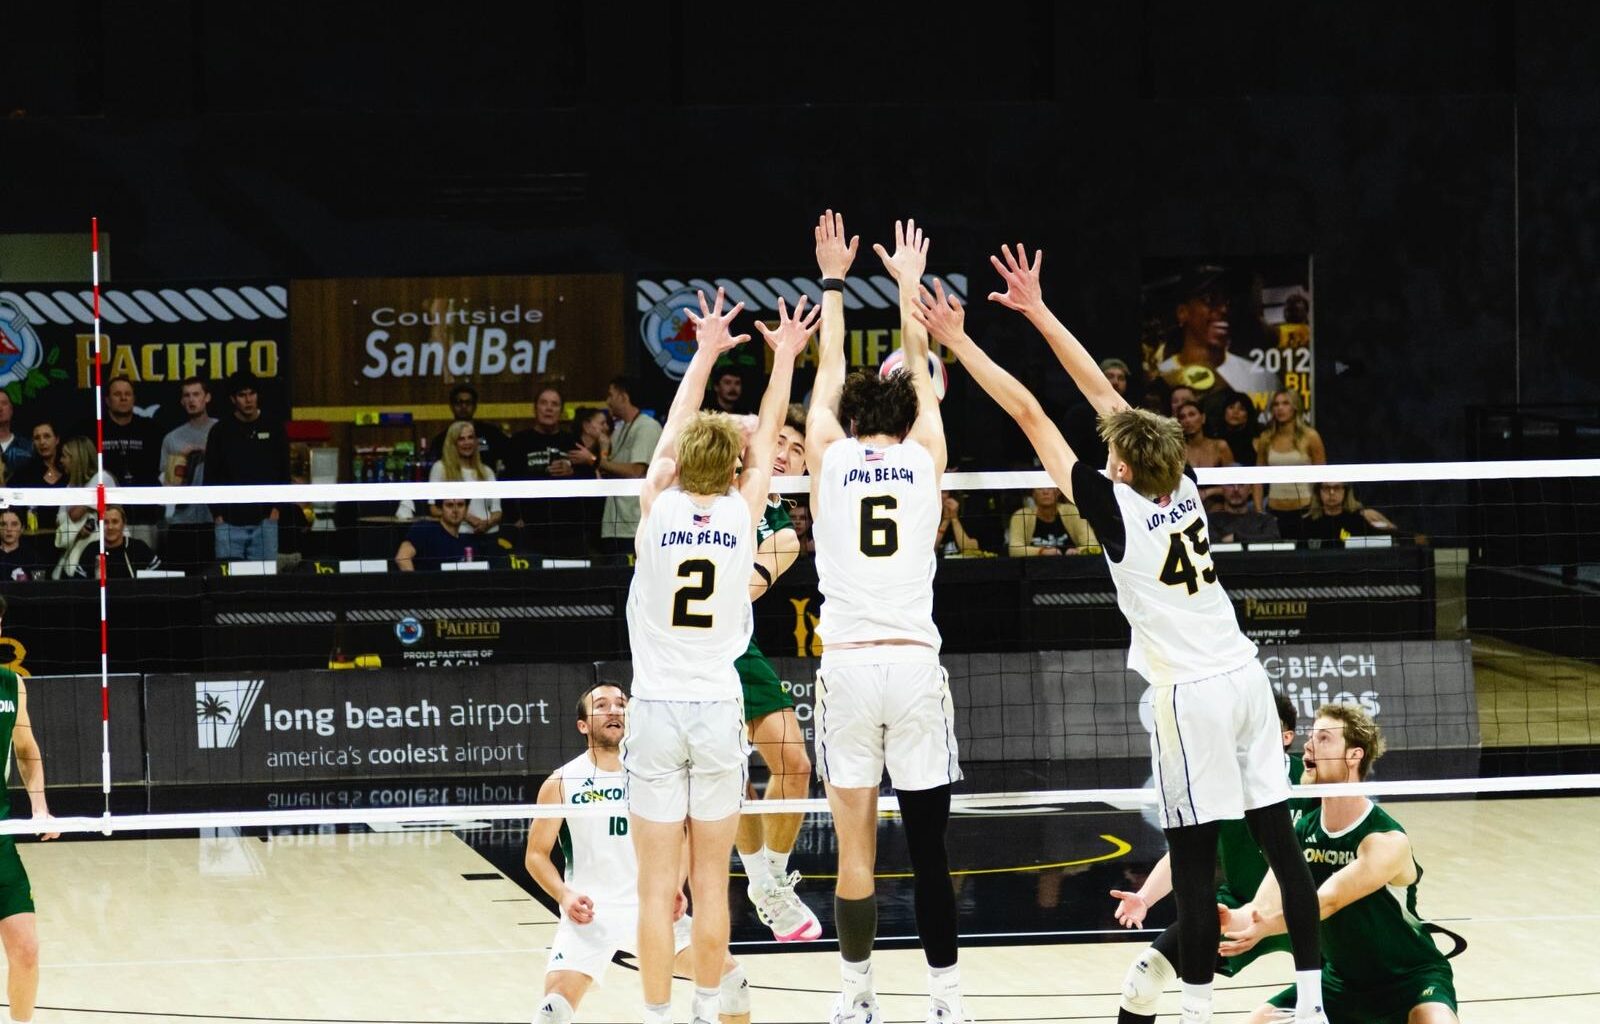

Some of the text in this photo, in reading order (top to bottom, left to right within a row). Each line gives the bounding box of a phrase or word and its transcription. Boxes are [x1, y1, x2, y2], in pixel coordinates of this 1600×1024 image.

[371, 304, 543, 327] Courtside
[362, 325, 556, 378] SandBar
[1249, 347, 1311, 373] 2012
[875, 467, 914, 485] BEACH
[859, 494, 899, 558] 6
[661, 530, 737, 549] LONG BEACH
[1159, 516, 1217, 596] 45
[671, 558, 716, 628] 2
[1246, 595, 1307, 617] PACIFICO
[435, 618, 500, 637] PACIFICO
[403, 649, 494, 660] PROUD PARTNER OF
[780, 680, 814, 697] Por
[264, 699, 550, 737] long beach airport
[267, 742, 525, 767] america's coolest airport
